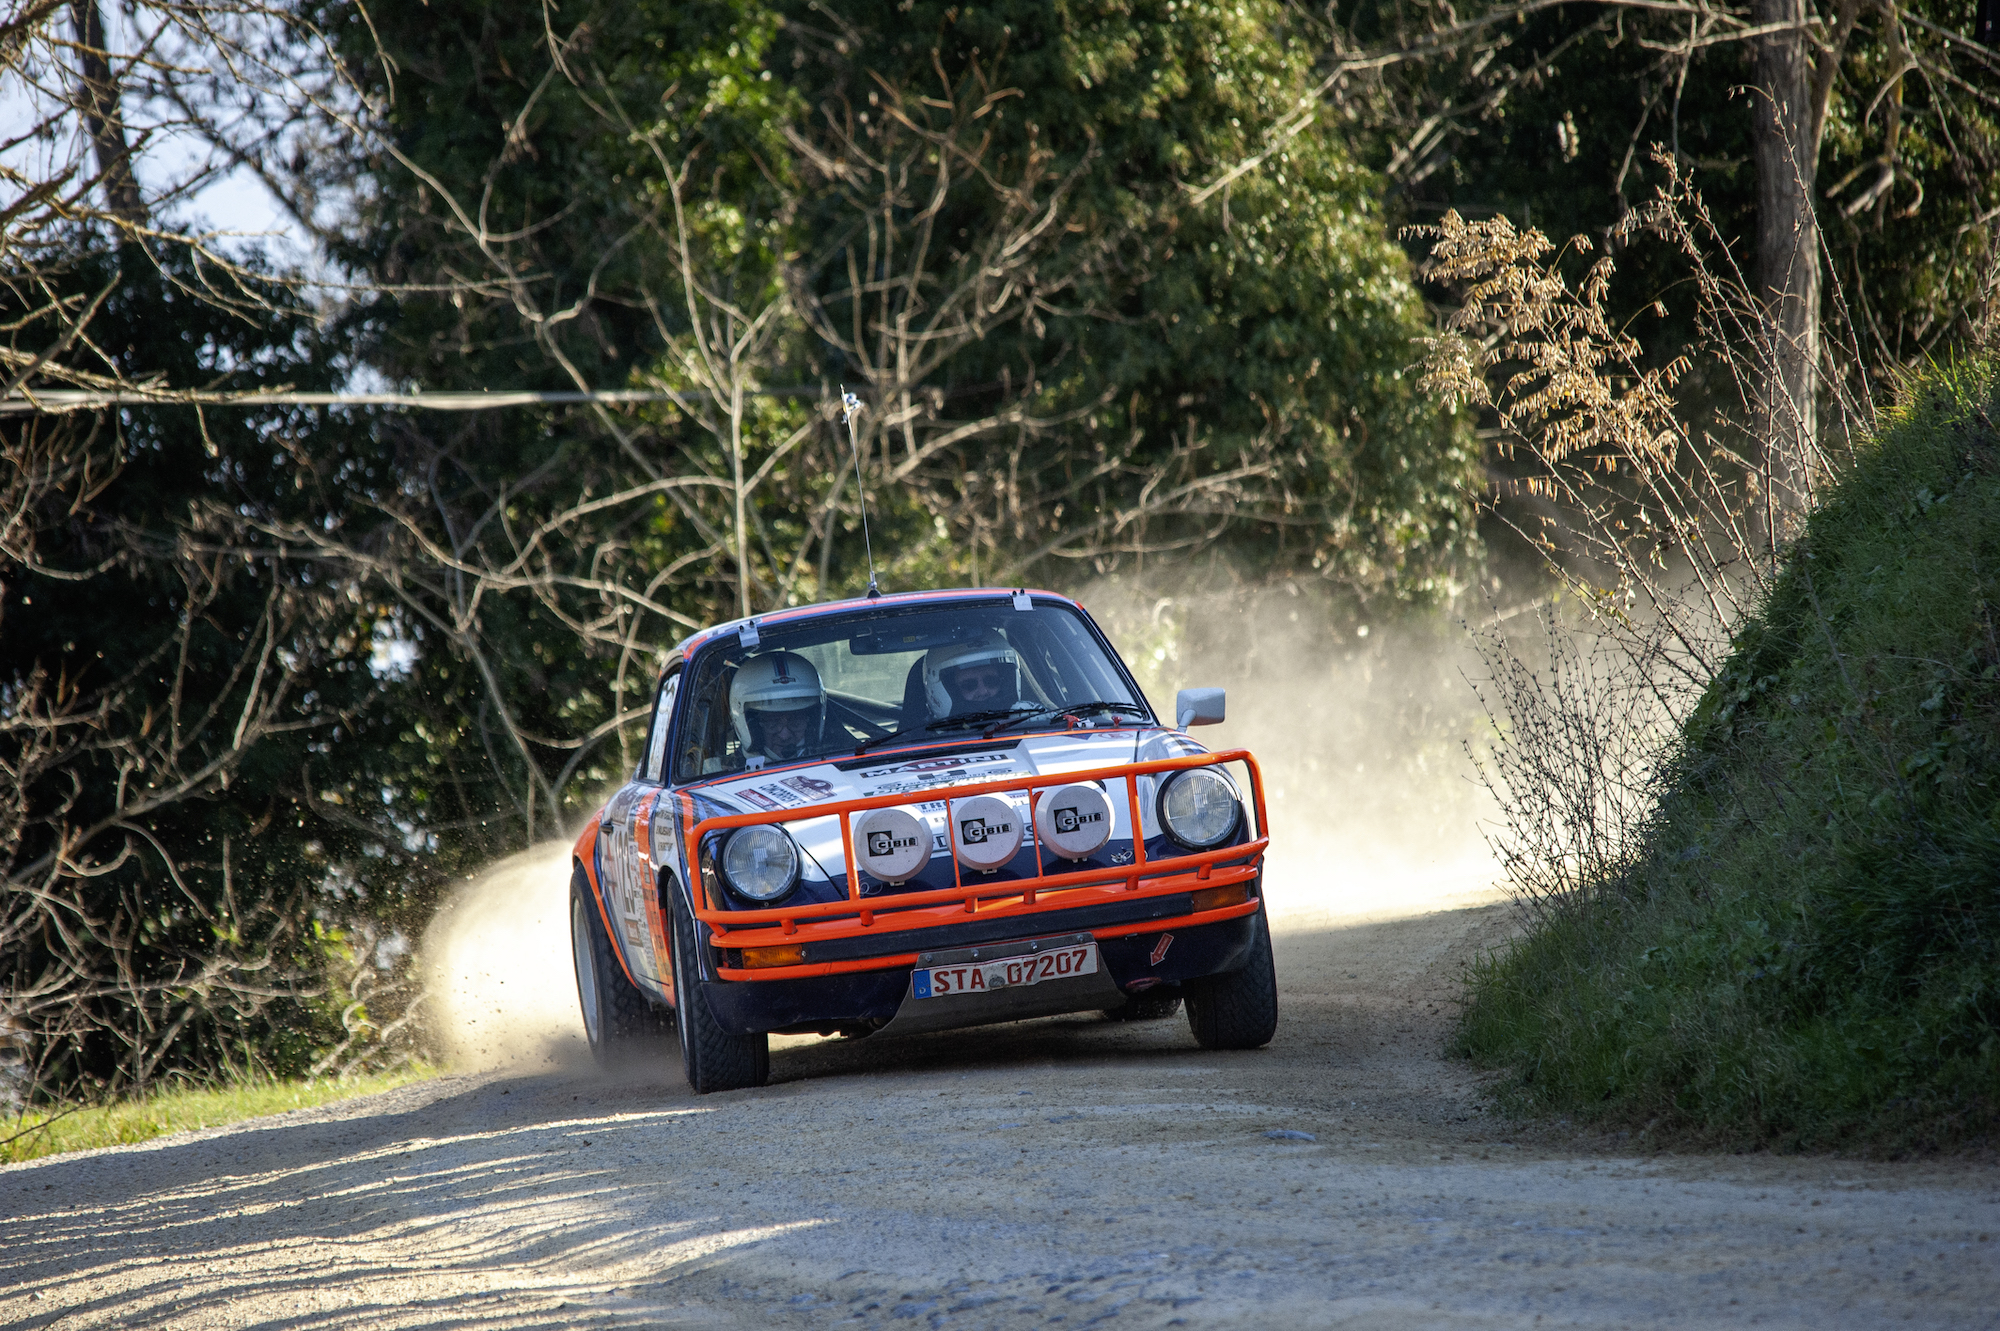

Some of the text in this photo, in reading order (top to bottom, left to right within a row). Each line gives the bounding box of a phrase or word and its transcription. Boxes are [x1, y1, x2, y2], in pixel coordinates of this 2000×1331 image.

[864, 754, 1005, 778] MARTINI
[934, 949, 1087, 993] STA 07207
